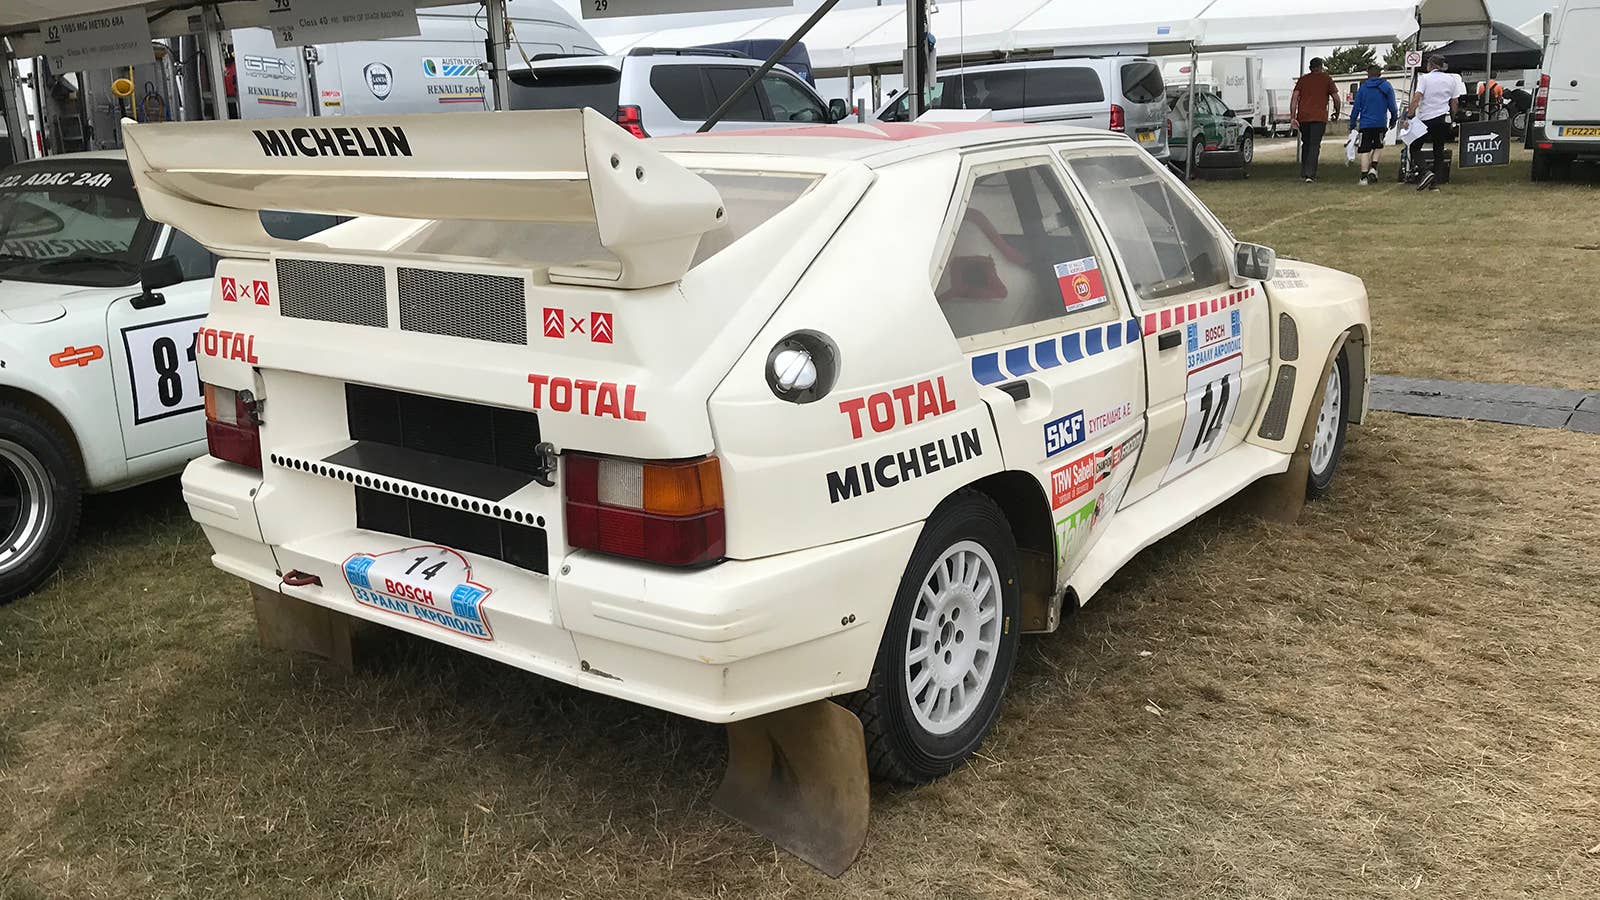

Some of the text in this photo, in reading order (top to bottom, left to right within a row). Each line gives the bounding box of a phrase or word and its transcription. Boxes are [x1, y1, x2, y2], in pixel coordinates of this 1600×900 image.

[595, 0, 608, 11] 29
[48, 26, 60, 40] 62
[78, 20, 88, 31] MG
[89, 17, 111, 29] METRO
[299, 17, 317, 27] Class
[319, 14, 328, 25] 40
[282, 31, 293, 41] 28
[246, 71, 297, 80] MOTORSPORT
[247, 86, 297, 99] RENAULT sport
[427, 85, 486, 97] RENAULT sport
[252, 126, 413, 157] MICHELIN
[1467, 140, 1502, 152] RALLY
[1475, 153, 1493, 163] HQ
[21, 172, 75, 186] ADAC
[72, 172, 113, 188] 24h
[1205, 324, 1226, 343] BOSCH
[196, 326, 259, 364] TOTAL
[1188, 354, 1196, 369] 33
[528, 374, 646, 421] TOTAL
[839, 376, 957, 440] TOTAL
[1185, 373, 1231, 465] 14
[1047, 414, 1083, 453] SKF
[826, 428, 983, 504] MICHELIN
[1053, 466, 1073, 495] TRW
[1073, 457, 1094, 486] Sabelt
[405, 556, 448, 581] 14
[353, 586, 370, 602] 33
[385, 578, 435, 606] BOSCH
